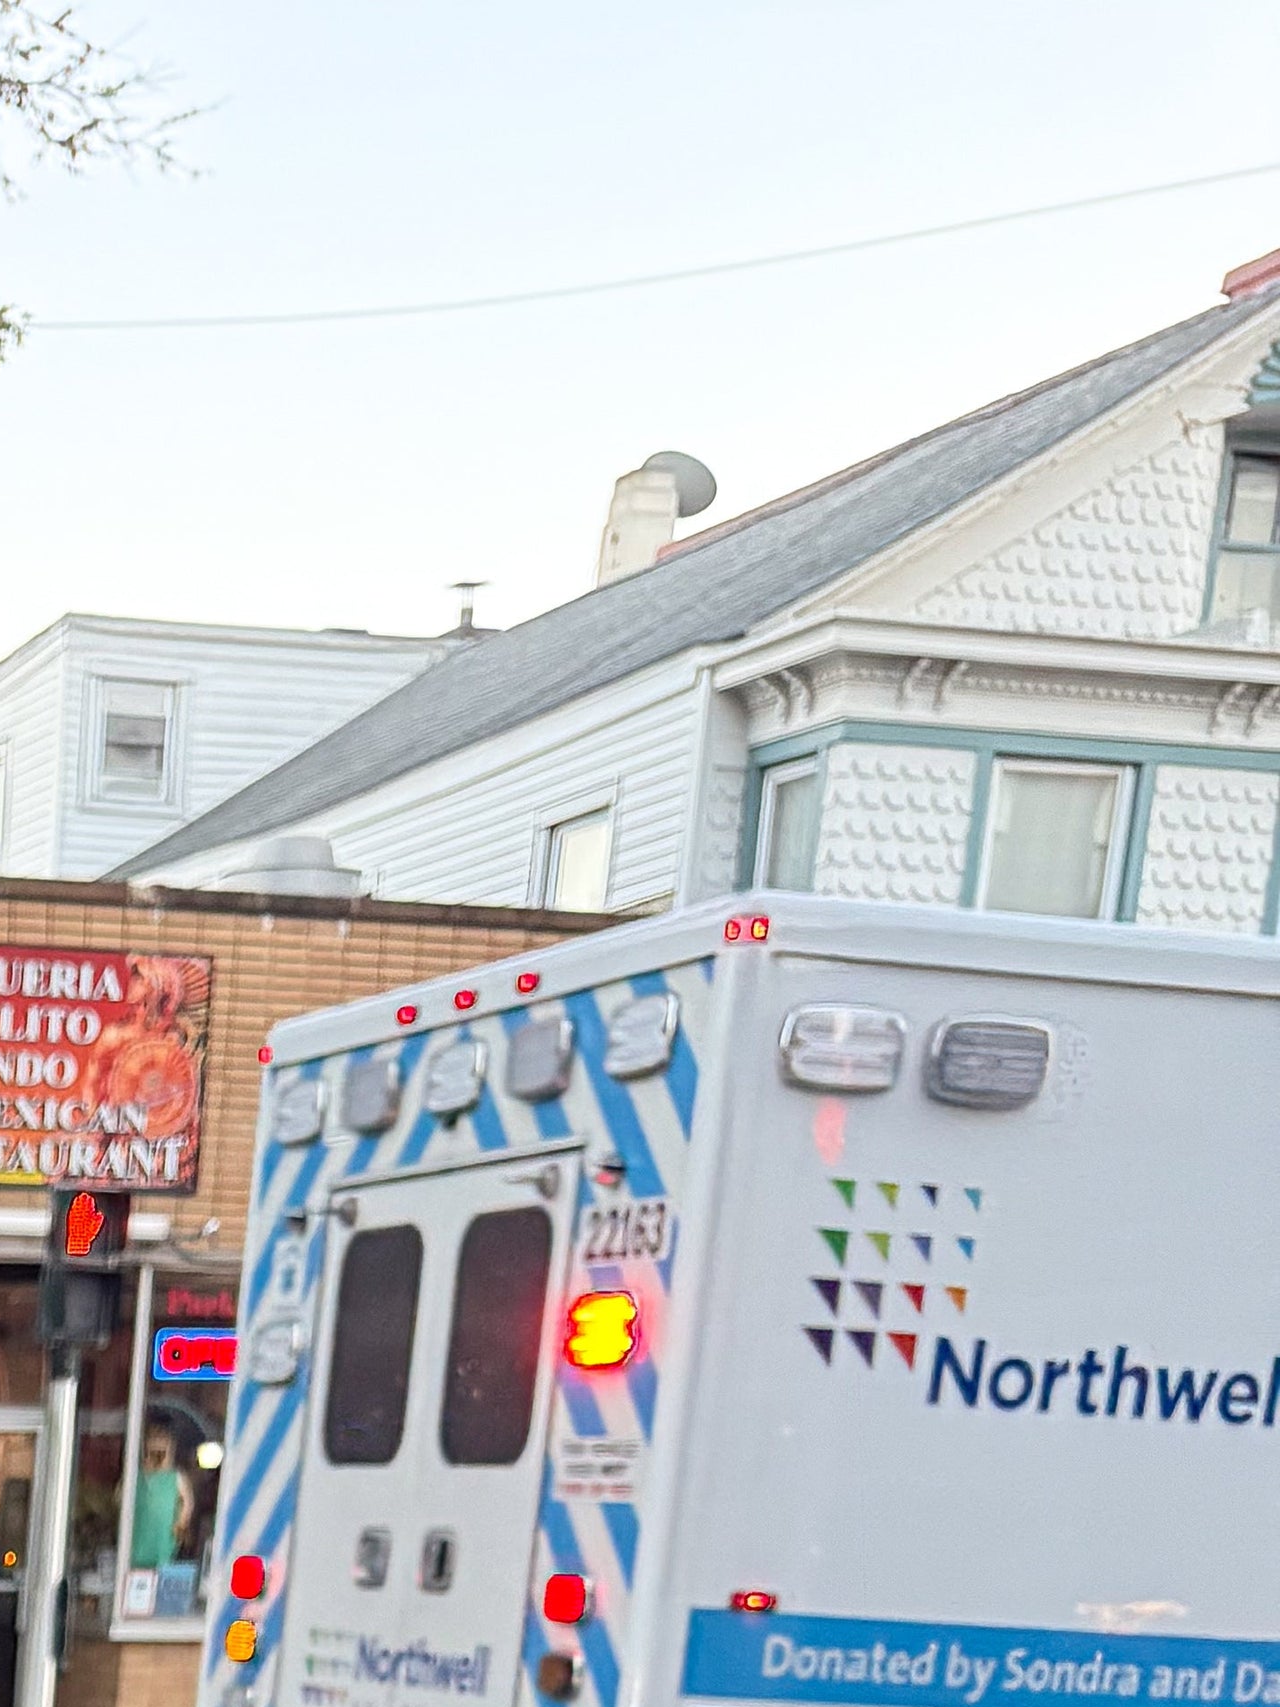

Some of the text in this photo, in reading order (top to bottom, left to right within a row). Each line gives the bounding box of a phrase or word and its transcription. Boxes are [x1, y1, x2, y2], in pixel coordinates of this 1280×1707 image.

[584, 1203, 666, 1261] 22163
[159, 1336, 239, 1375] OPE
[926, 1334, 1280, 1428] Northwel
[355, 1632, 491, 1697] Northwell
[761, 1633, 1280, 1704] Donated by Sondra and Da
